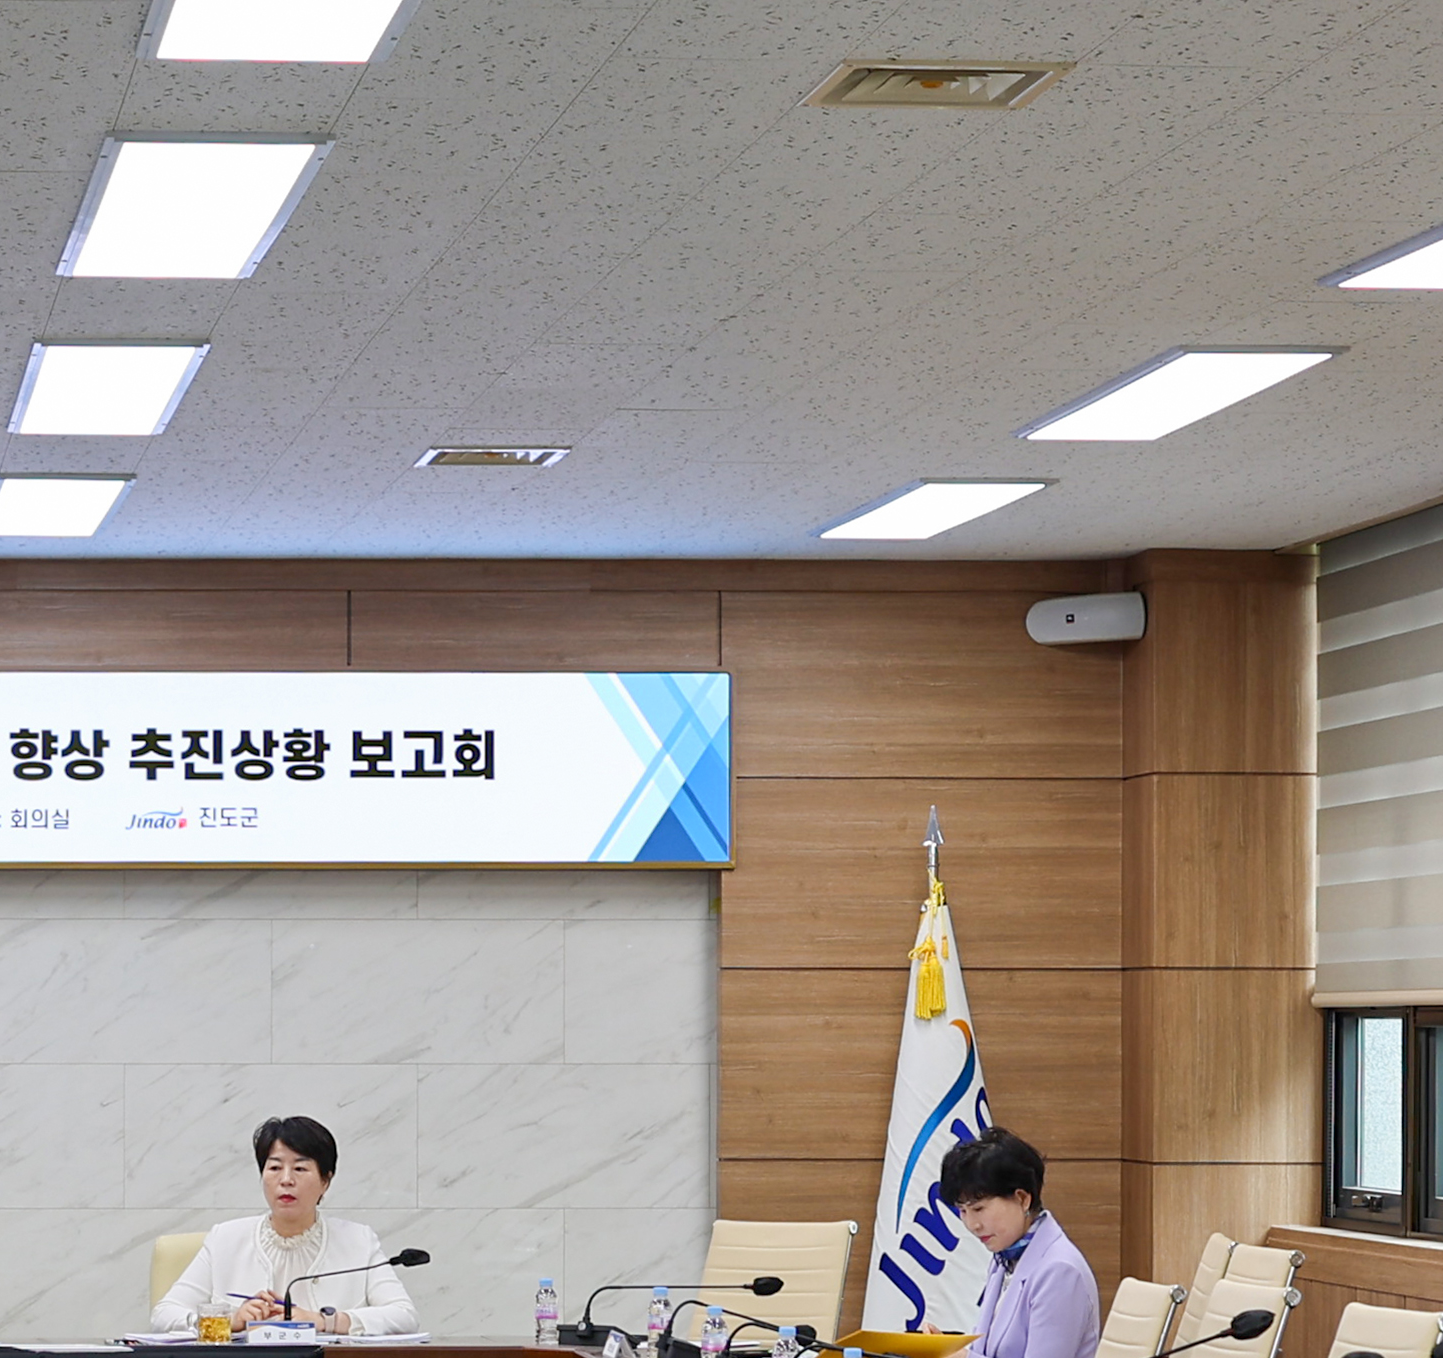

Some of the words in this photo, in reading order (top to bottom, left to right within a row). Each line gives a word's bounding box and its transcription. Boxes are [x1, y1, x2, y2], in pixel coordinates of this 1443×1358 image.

[9, 728, 110, 782] 향상
[129, 728, 331, 782] 추진상황
[350, 728, 495, 781] 보고회
[11, 808, 70, 830] 회의실
[126, 809, 178, 830] Jindo
[199, 807, 259, 829] 진도군
